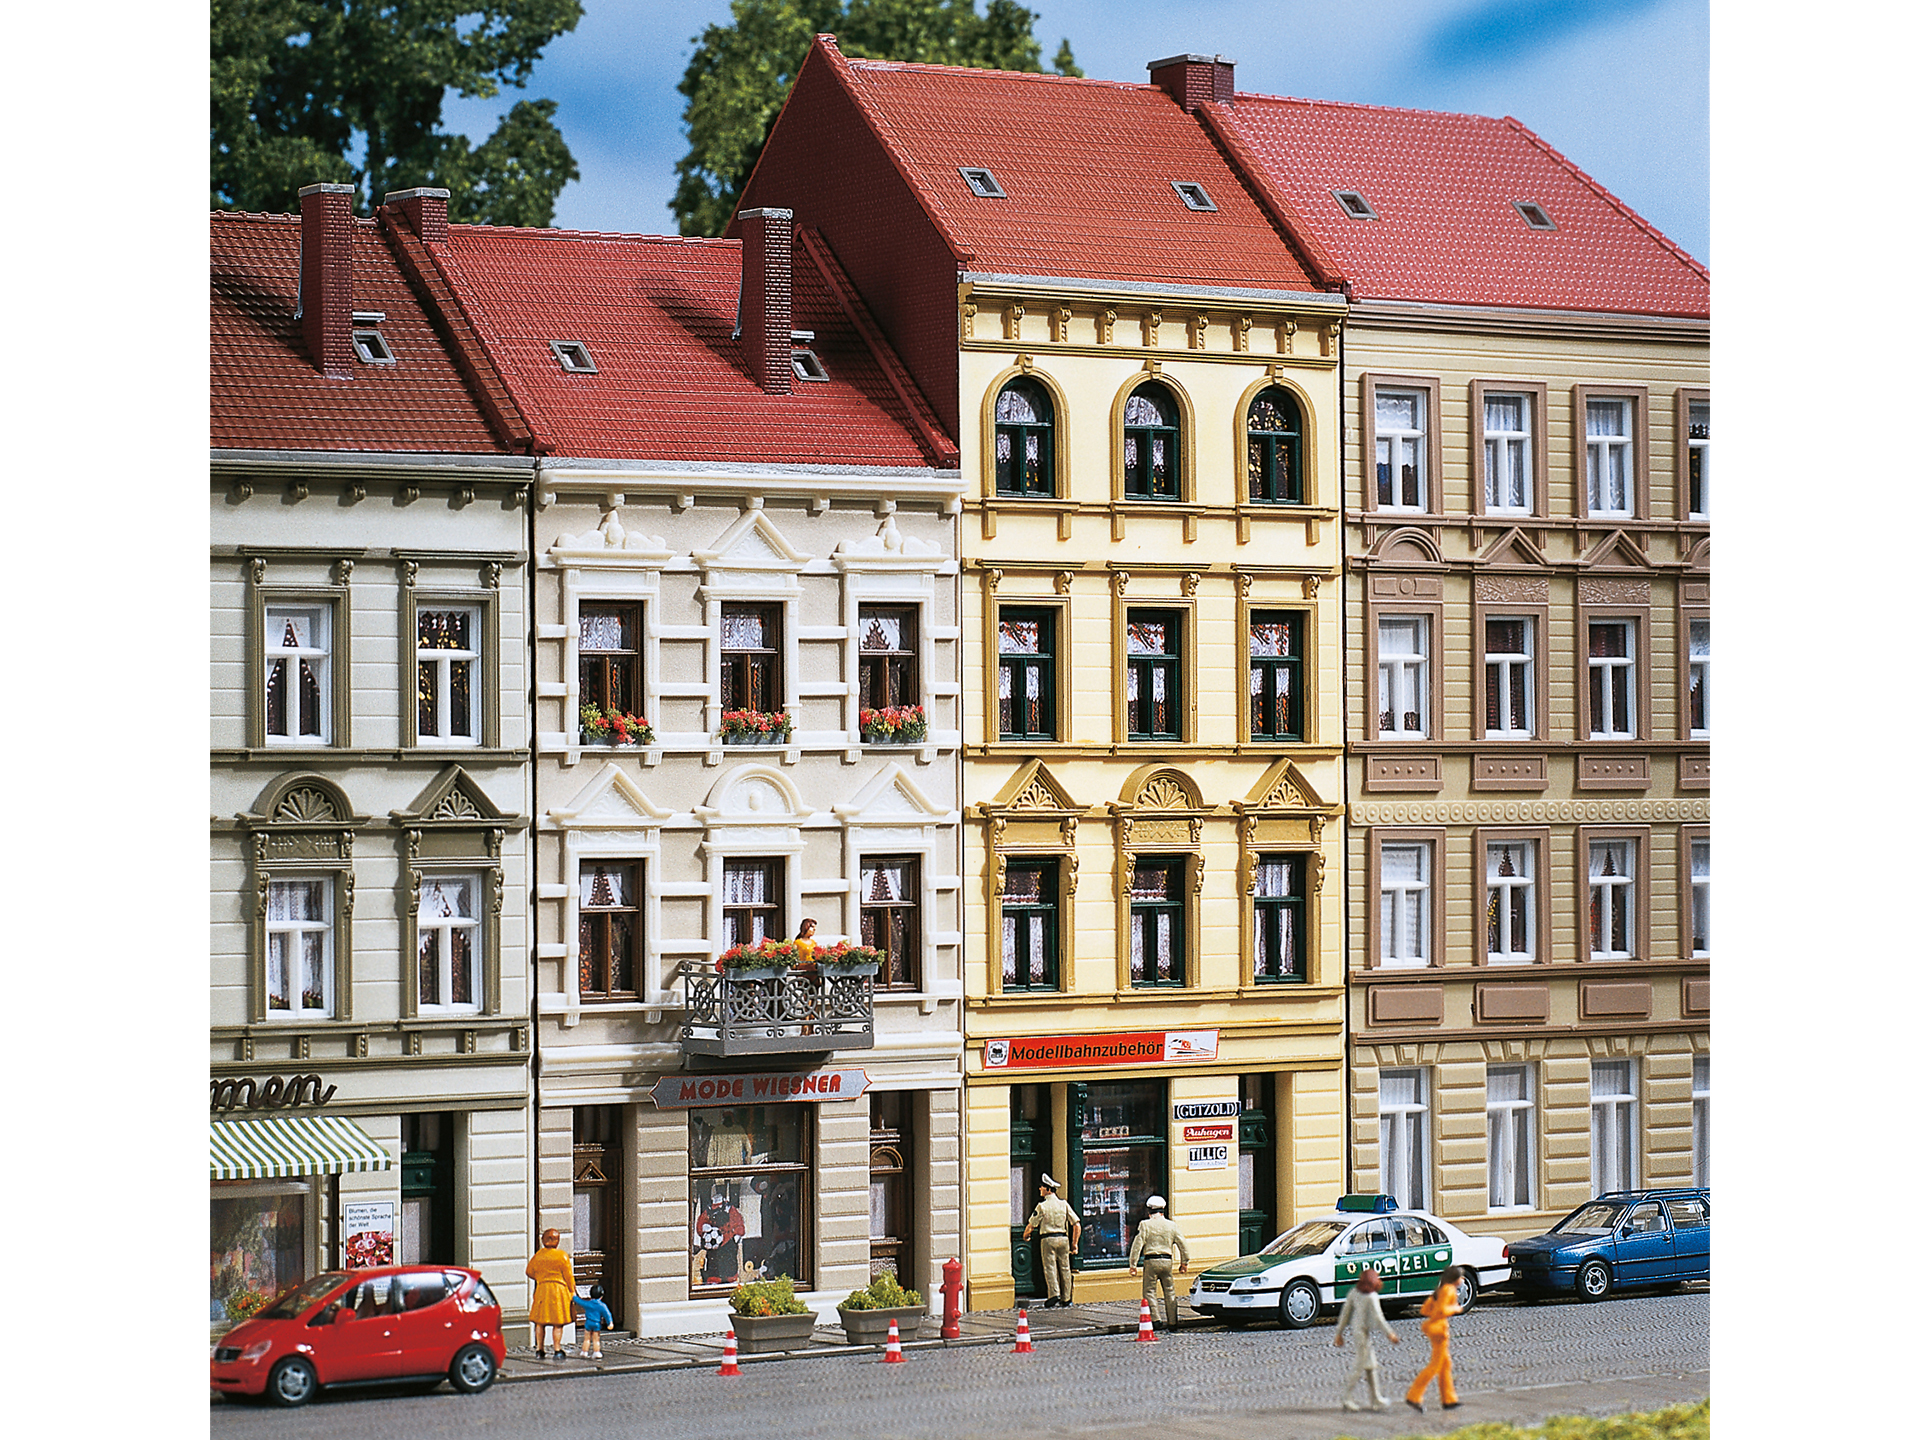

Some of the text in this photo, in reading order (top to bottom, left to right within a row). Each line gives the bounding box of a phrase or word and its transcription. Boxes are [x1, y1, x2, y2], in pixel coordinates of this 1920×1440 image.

[1011, 1041, 1163, 1061] Modellbahnzubehör
[679, 1074, 842, 1100] MODE WIESNER
[1186, 1128, 1230, 1138] Auhagen
[1190, 1147, 1226, 1160] TILLIG
